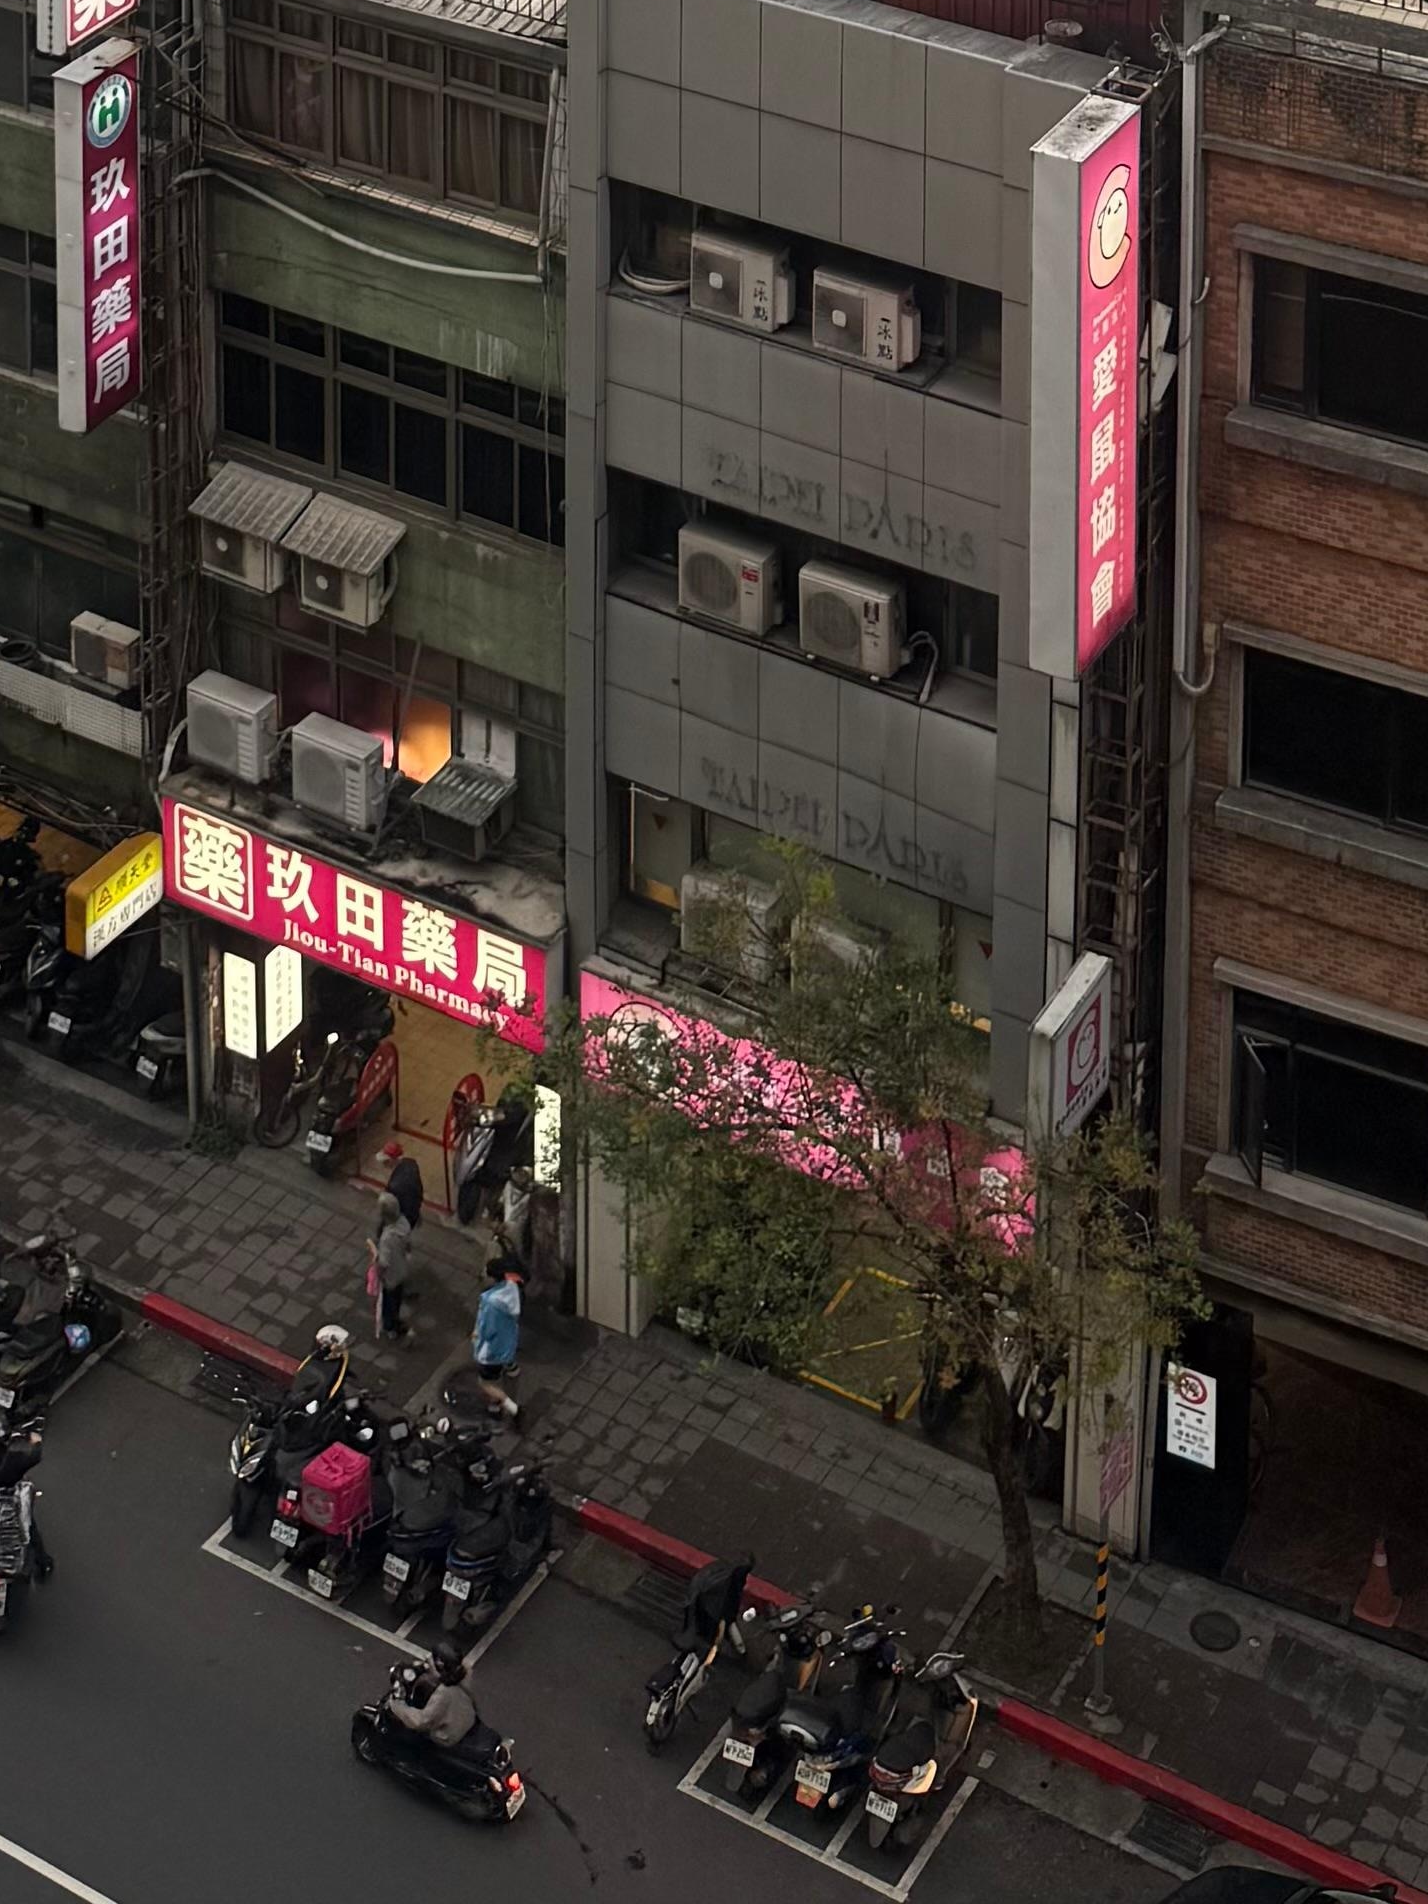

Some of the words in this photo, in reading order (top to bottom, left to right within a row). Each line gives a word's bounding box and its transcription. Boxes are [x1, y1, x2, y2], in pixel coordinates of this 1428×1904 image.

[89, 155, 133, 404] 玖田藥局
[1090, 336, 1117, 629] 愛鼠協會
[181, 815, 247, 911] 藥
[266, 843, 527, 1010] 玖田藥局
[283, 917, 390, 980] Jiou-Tian
[394, 963, 509, 1032] Pharmacy
